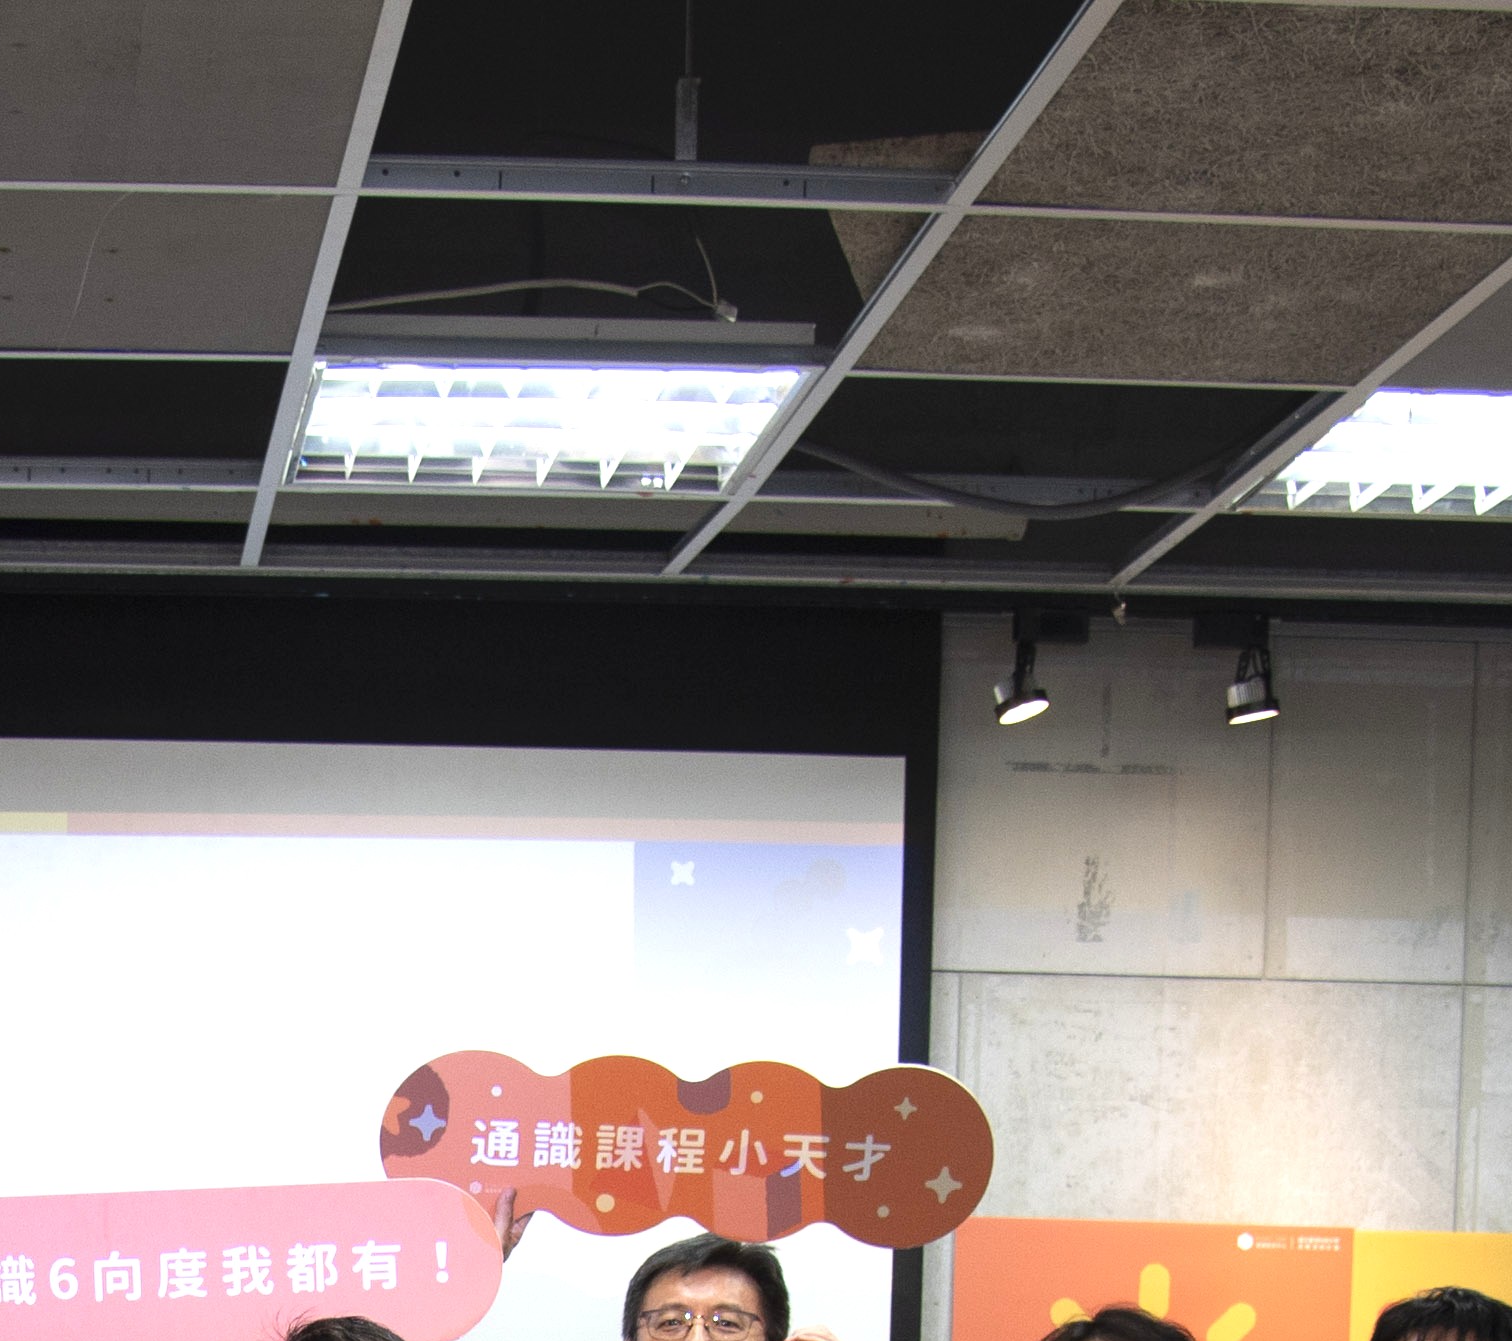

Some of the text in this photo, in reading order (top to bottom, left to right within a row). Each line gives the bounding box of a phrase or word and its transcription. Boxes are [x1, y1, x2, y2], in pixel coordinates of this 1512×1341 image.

[470, 1119, 891, 1182] 通識課程小天才
